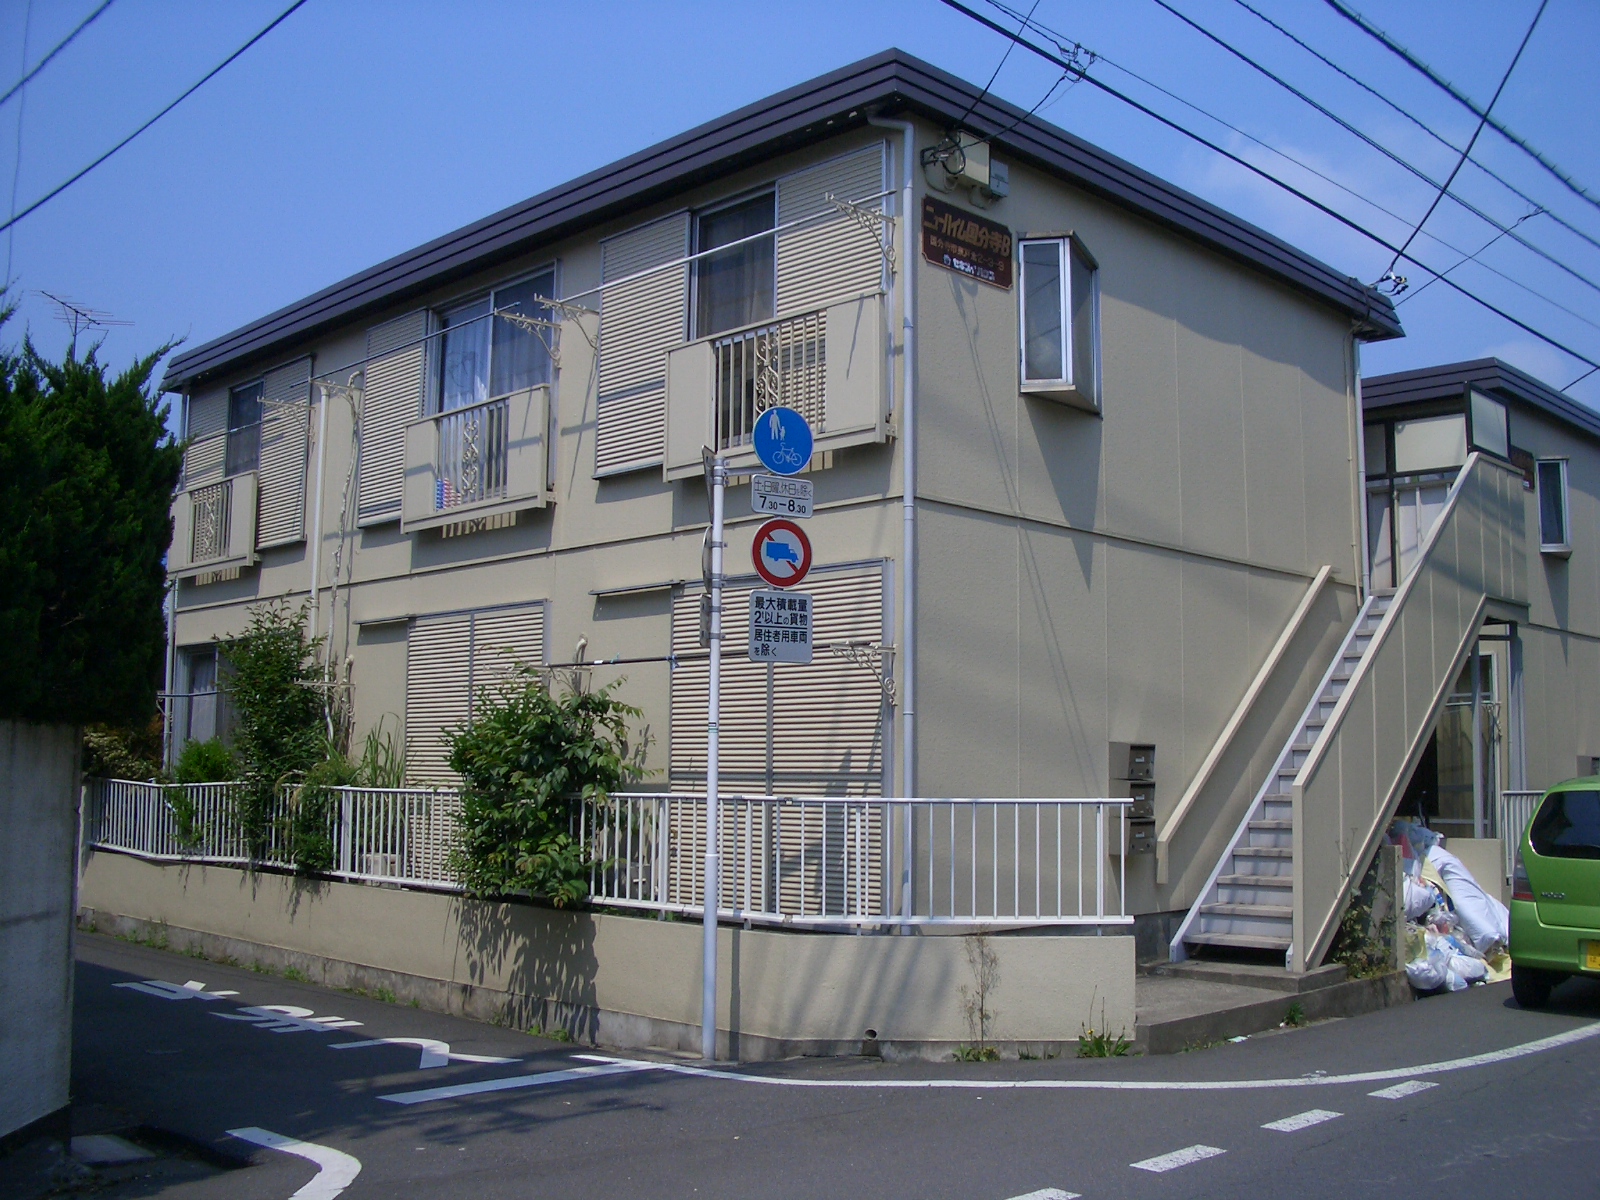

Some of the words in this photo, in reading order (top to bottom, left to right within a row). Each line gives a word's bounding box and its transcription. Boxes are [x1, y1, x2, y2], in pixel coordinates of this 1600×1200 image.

[755, 596, 808, 612] 最大積載量
[754, 628, 808, 644] 居住者用車両
[754, 643, 777, 657] を除く
